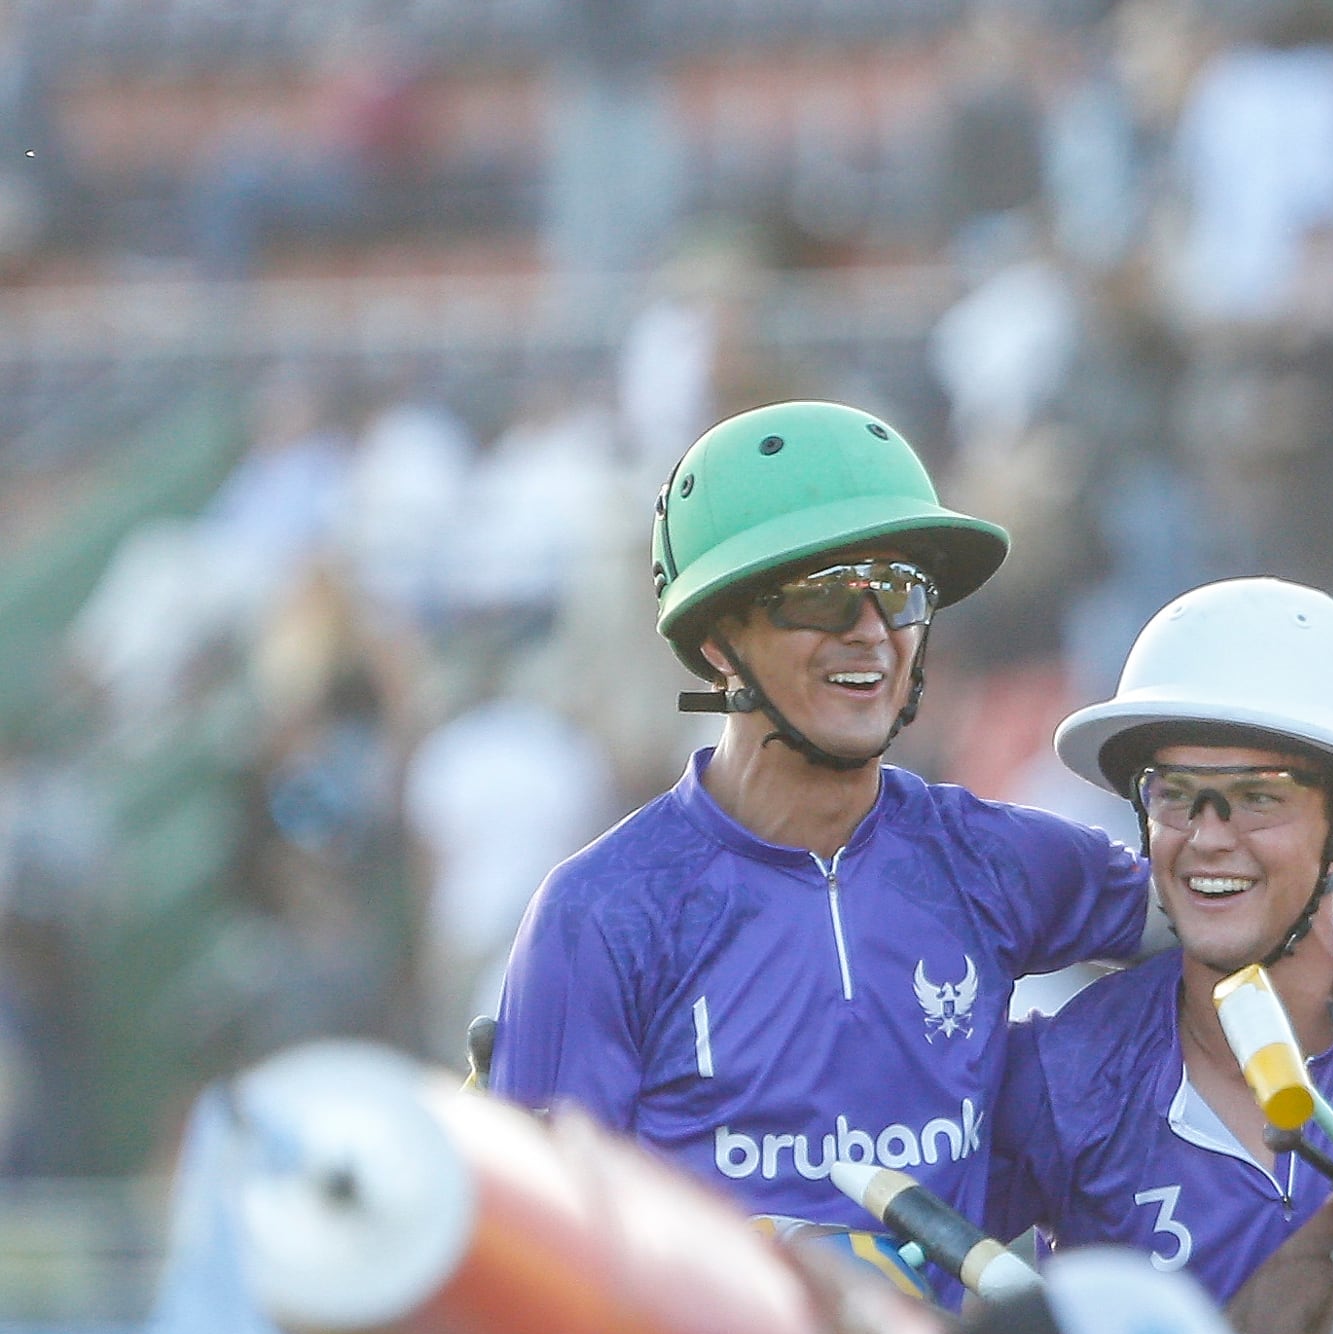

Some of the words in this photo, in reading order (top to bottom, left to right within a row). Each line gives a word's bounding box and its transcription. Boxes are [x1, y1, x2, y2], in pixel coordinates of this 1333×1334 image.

[692, 995, 714, 1078] 1
[715, 1097, 985, 1181] brubank
[1134, 1184, 1193, 1273] 3
